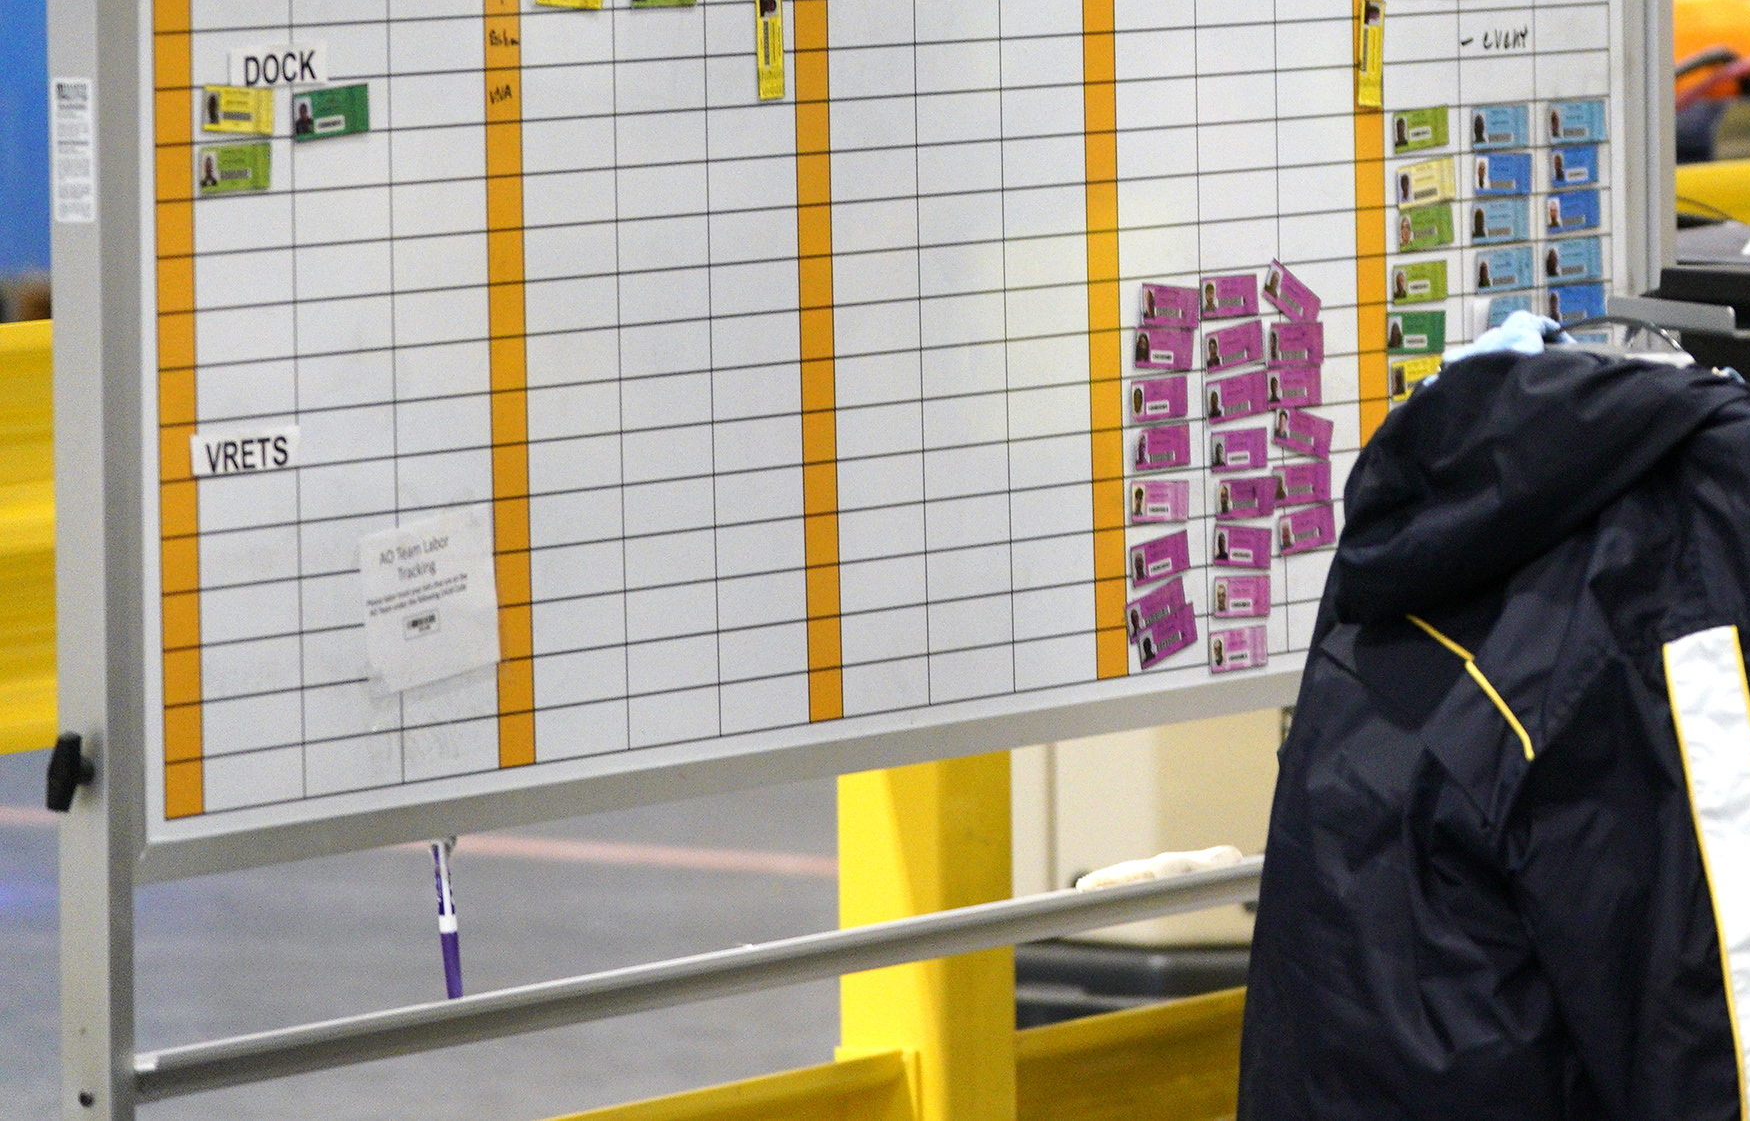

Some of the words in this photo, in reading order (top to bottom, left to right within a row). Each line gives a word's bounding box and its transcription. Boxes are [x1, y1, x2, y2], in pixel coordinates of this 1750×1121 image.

[245, 50, 317, 87] DOCK
[205, 436, 289, 473] VRETS
[396, 544, 421, 560] Team
[423, 536, 448, 554] Labor
